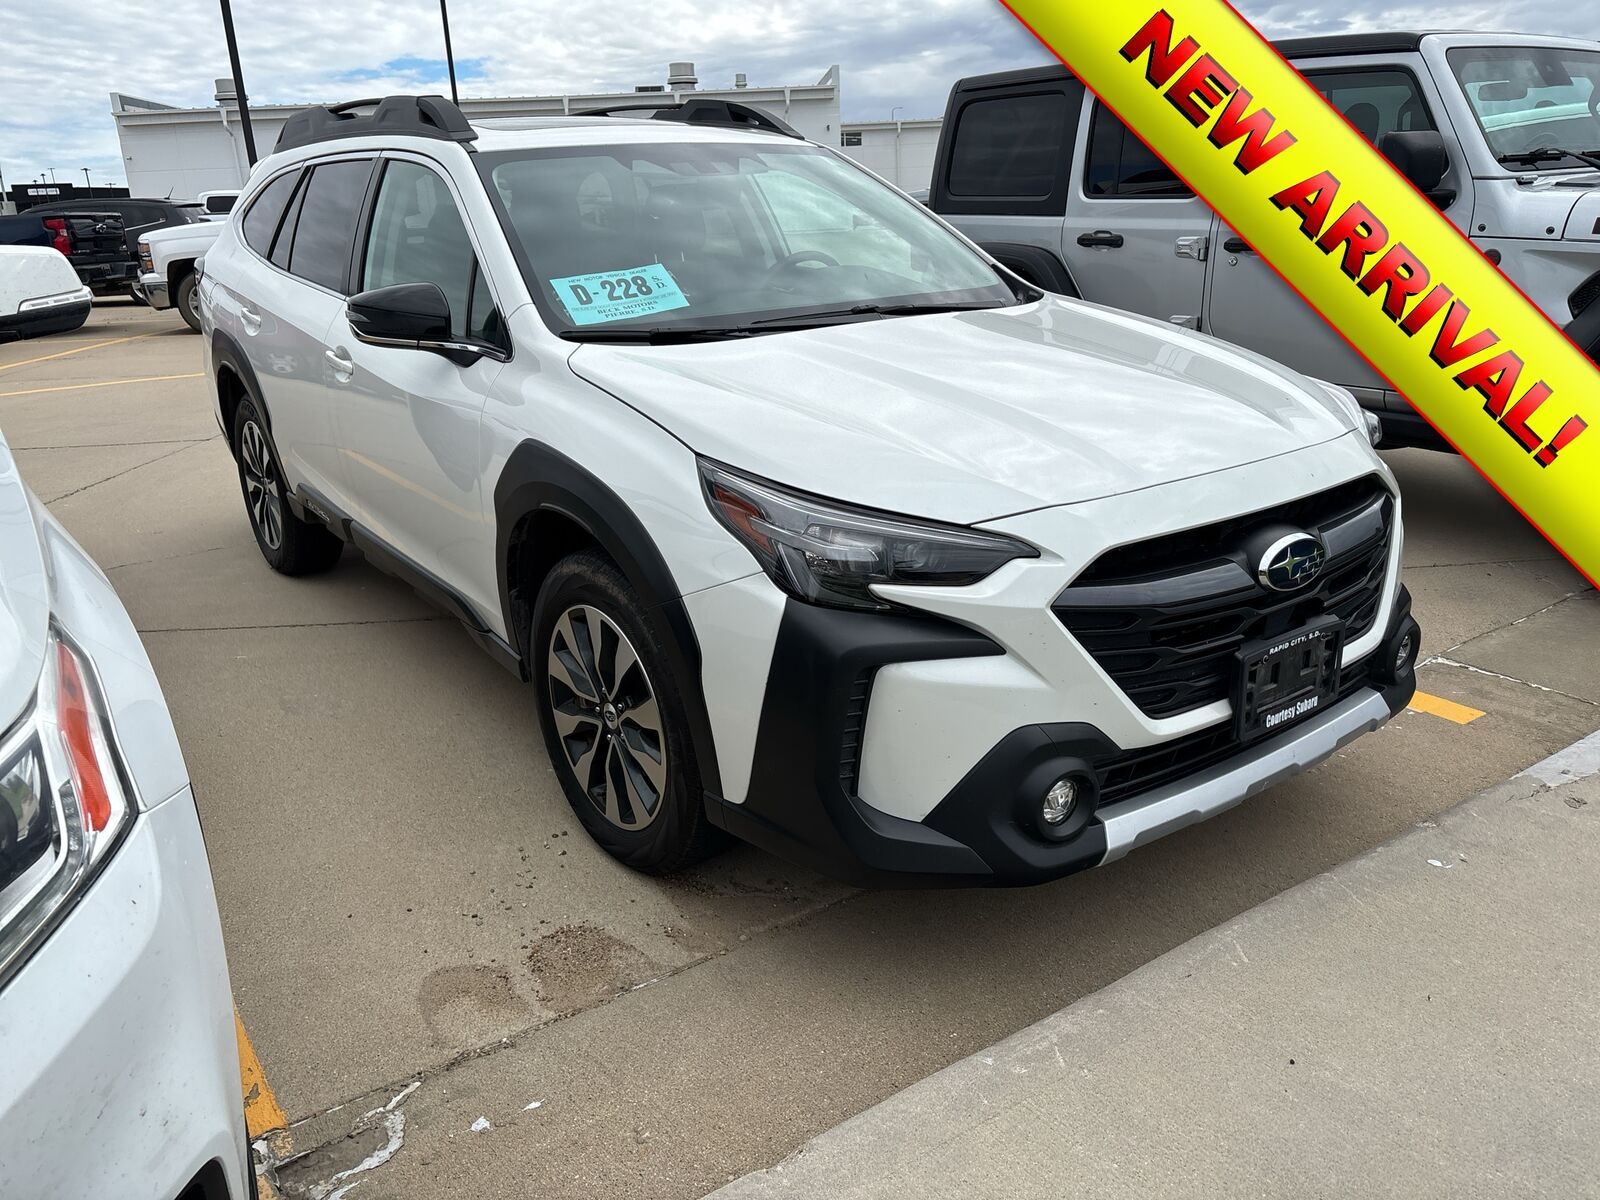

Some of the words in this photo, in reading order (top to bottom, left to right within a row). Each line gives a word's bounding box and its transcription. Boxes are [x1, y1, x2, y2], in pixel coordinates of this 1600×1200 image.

[569, 275, 653, 306] D-228
[597, 306, 621, 315] BECK
[623, 300, 658, 309] MOTORS
[641, 305, 656, 313] S.D.
[1269, 642, 1289, 655] RAPID
[1290, 635, 1307, 647] CITY,
[1308, 631, 1321, 640] S.D.
[1266, 706, 1296, 728] Courtesy
[1296, 695, 1318, 715] Subaru
